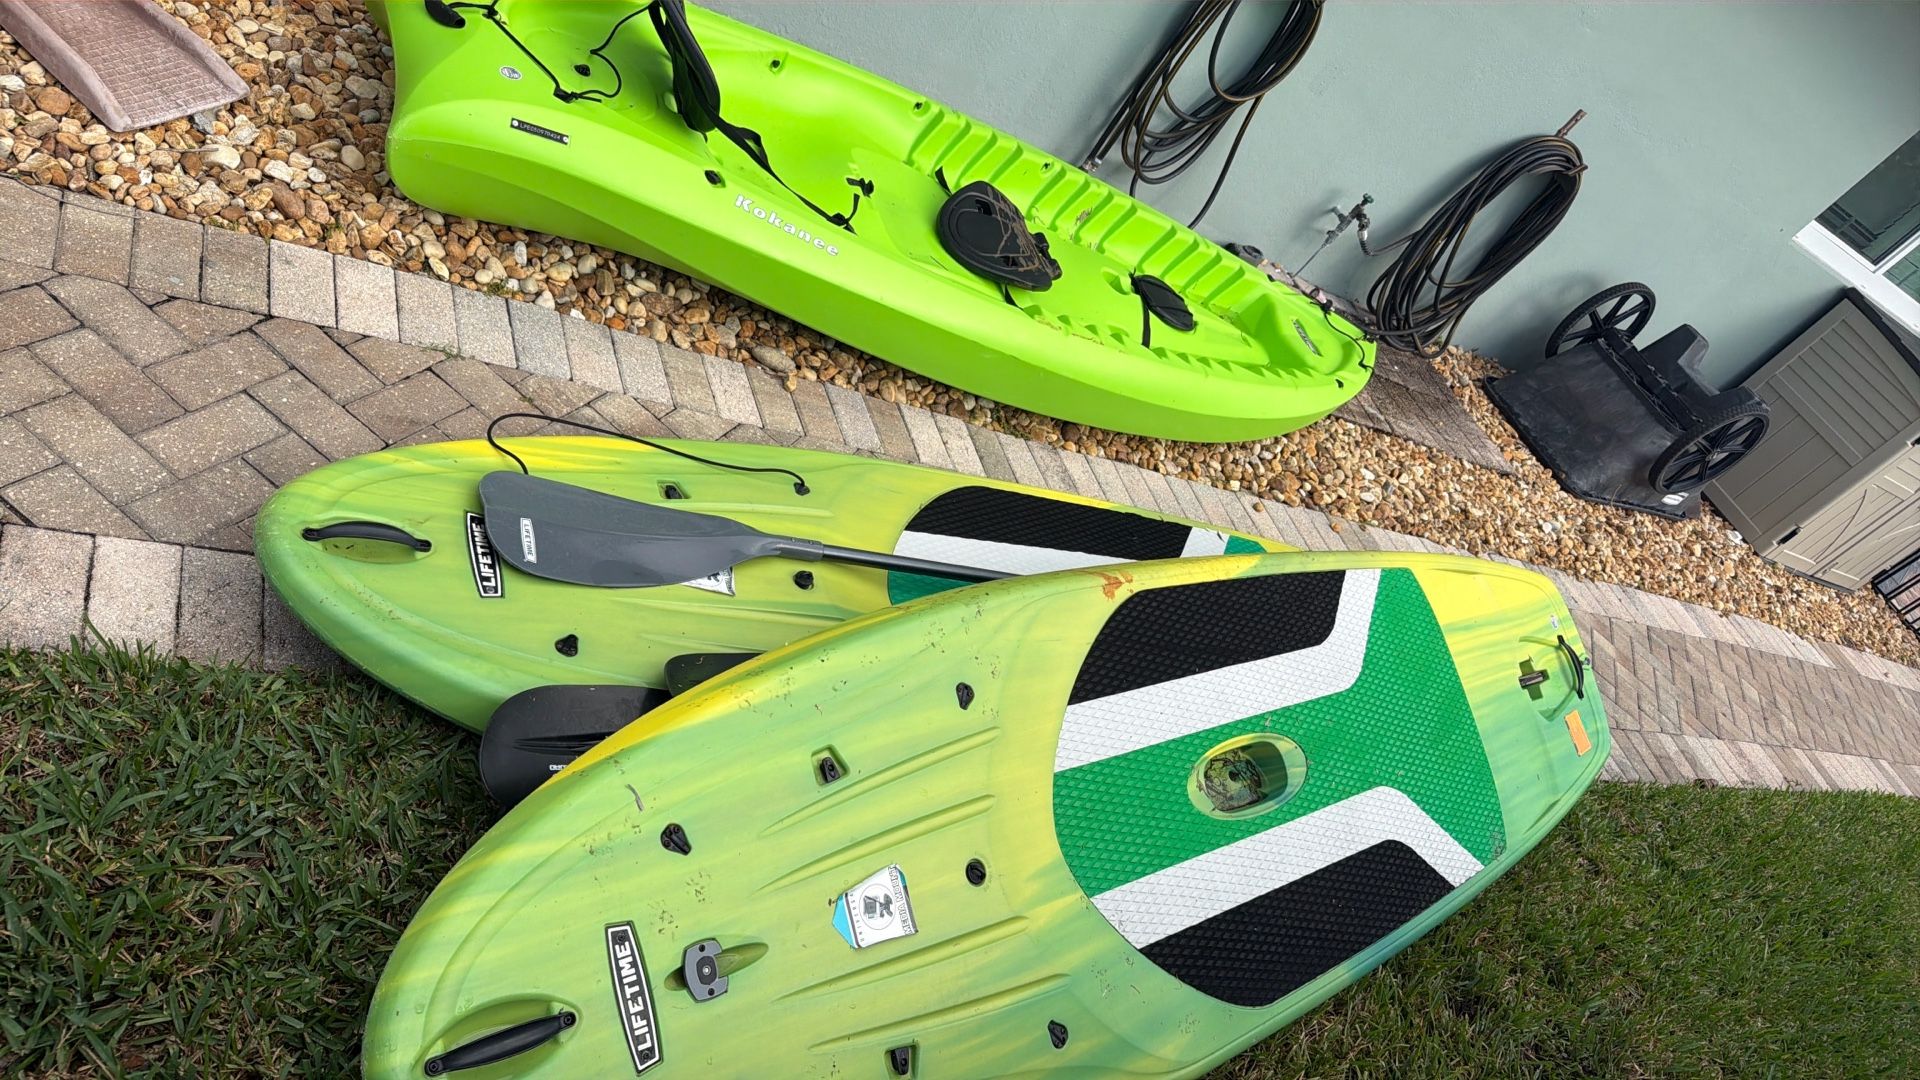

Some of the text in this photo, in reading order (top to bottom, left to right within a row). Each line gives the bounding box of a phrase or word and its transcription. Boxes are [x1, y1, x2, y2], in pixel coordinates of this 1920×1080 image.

[735, 194, 839, 256] Kokanee
[472, 522, 496, 587] LIFETIME
[523, 523, 534, 556] LIFETIME
[887, 866, 913, 935] MEDIA MOUNT
[614, 940, 653, 1051] LIFETIME
